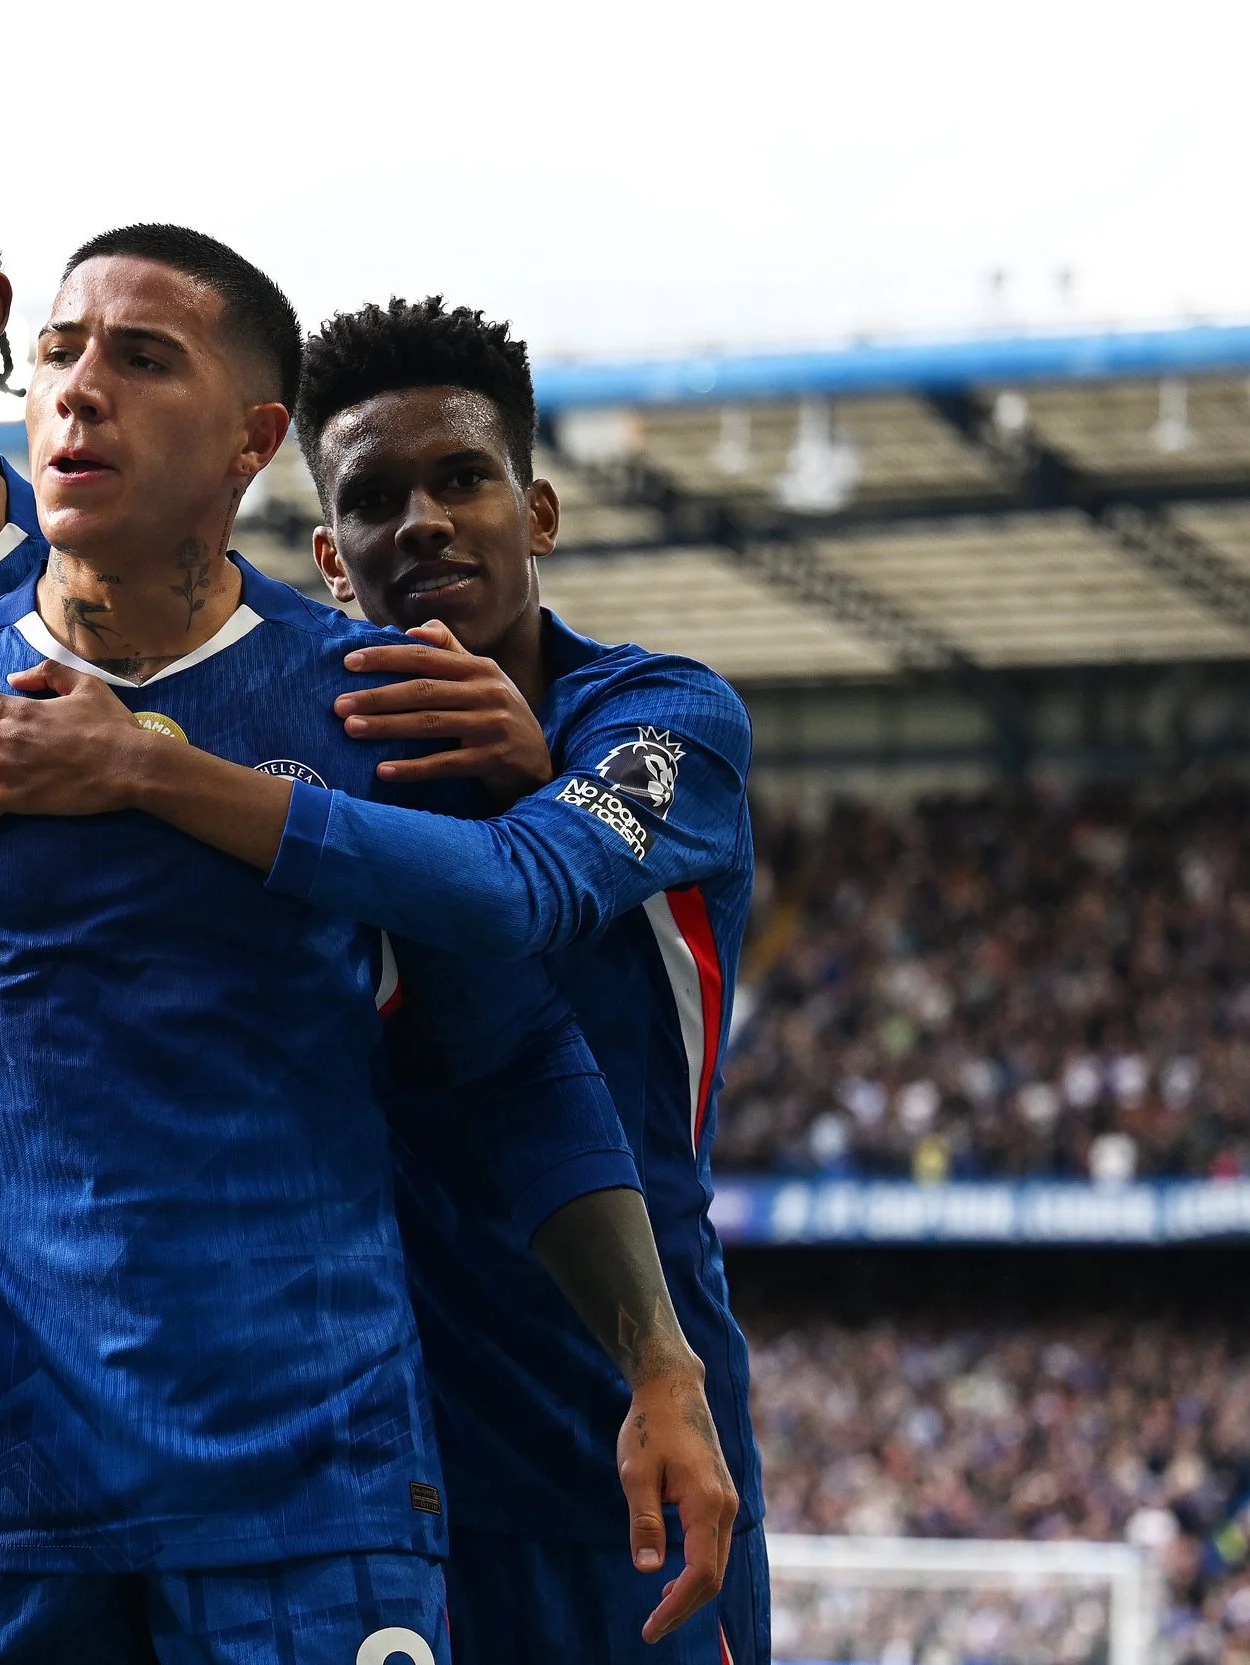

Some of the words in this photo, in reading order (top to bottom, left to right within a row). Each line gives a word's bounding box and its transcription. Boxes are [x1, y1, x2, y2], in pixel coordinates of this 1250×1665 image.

[139, 719, 175, 738] AMP
[260, 763, 313, 784] HELSEA
[555, 791, 591, 807] for
[588, 803, 646, 862] racism
[563, 779, 598, 798] No
[598, 792, 647, 843] room
